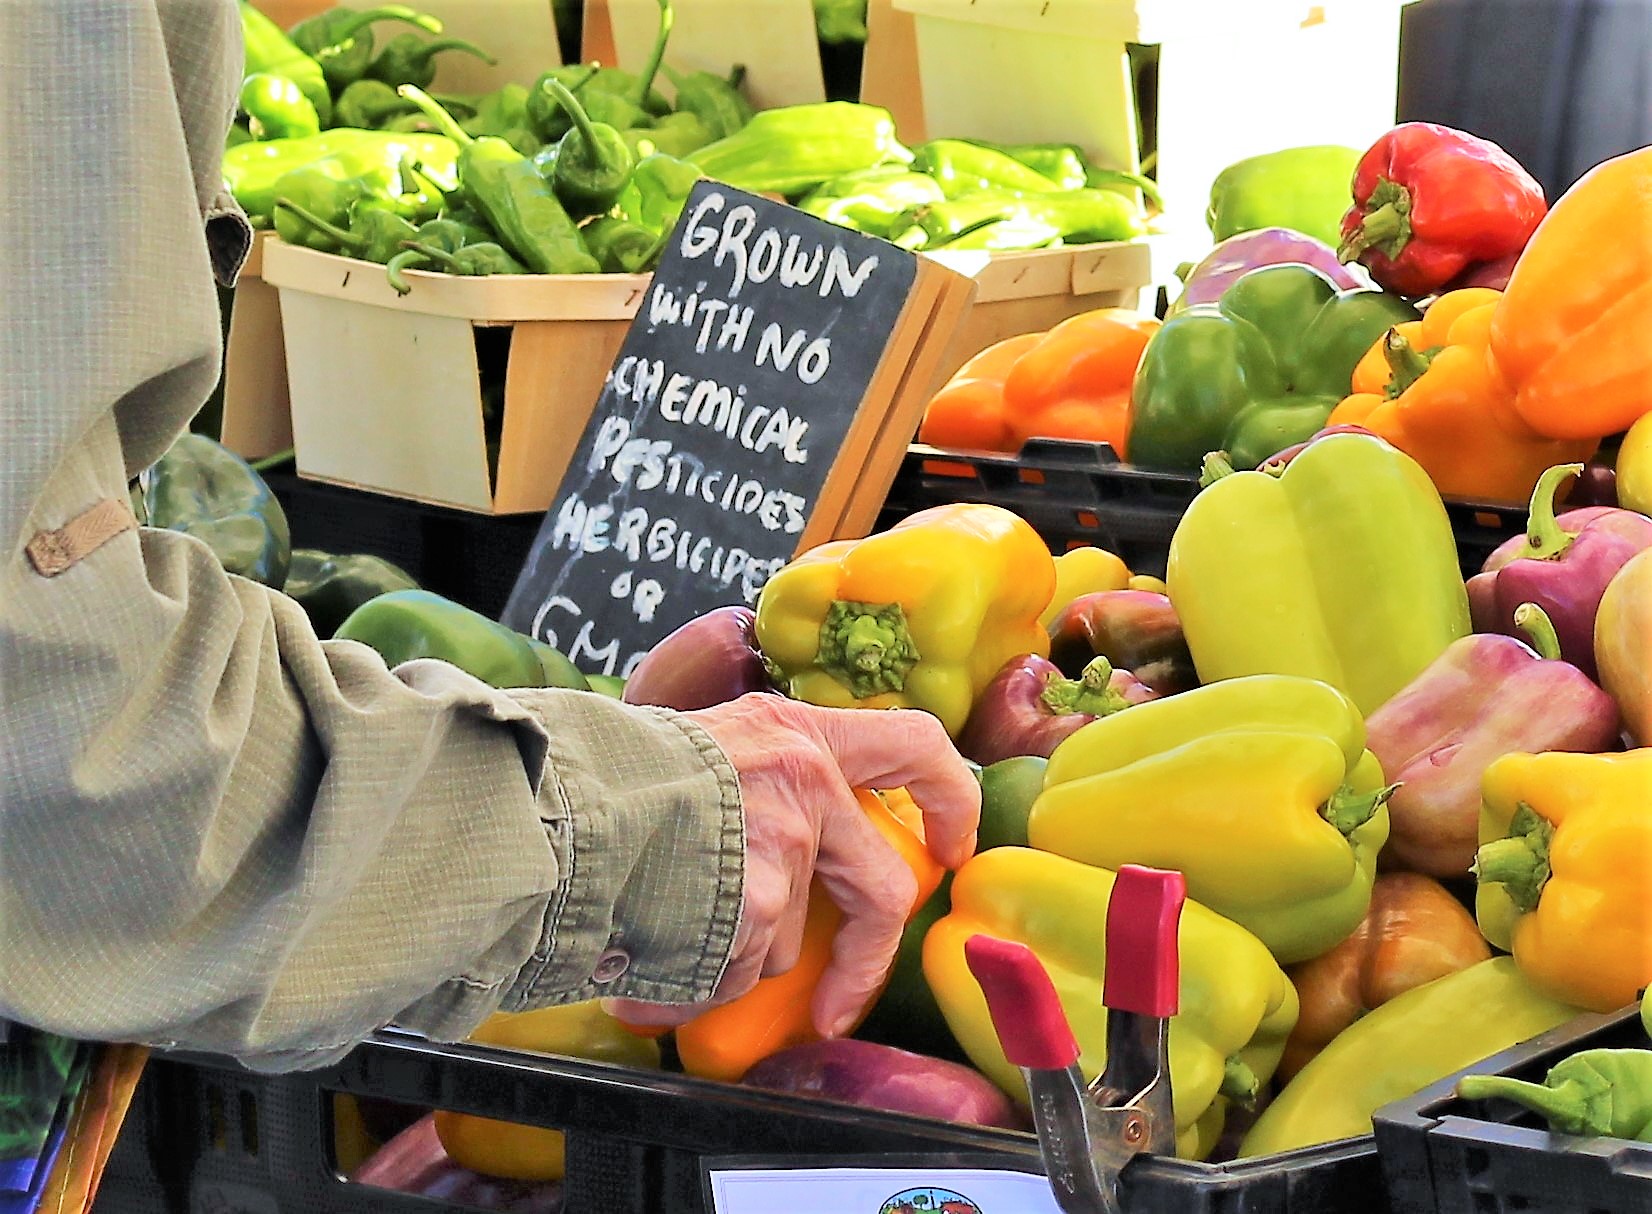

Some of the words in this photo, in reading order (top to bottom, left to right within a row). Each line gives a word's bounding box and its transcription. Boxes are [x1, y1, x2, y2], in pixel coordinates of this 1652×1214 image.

[680, 193, 879, 298] GROWN
[755, 321, 831, 384] NO
[588, 415, 807, 534] PESTICIDES
[610, 571, 665, 623] OR
